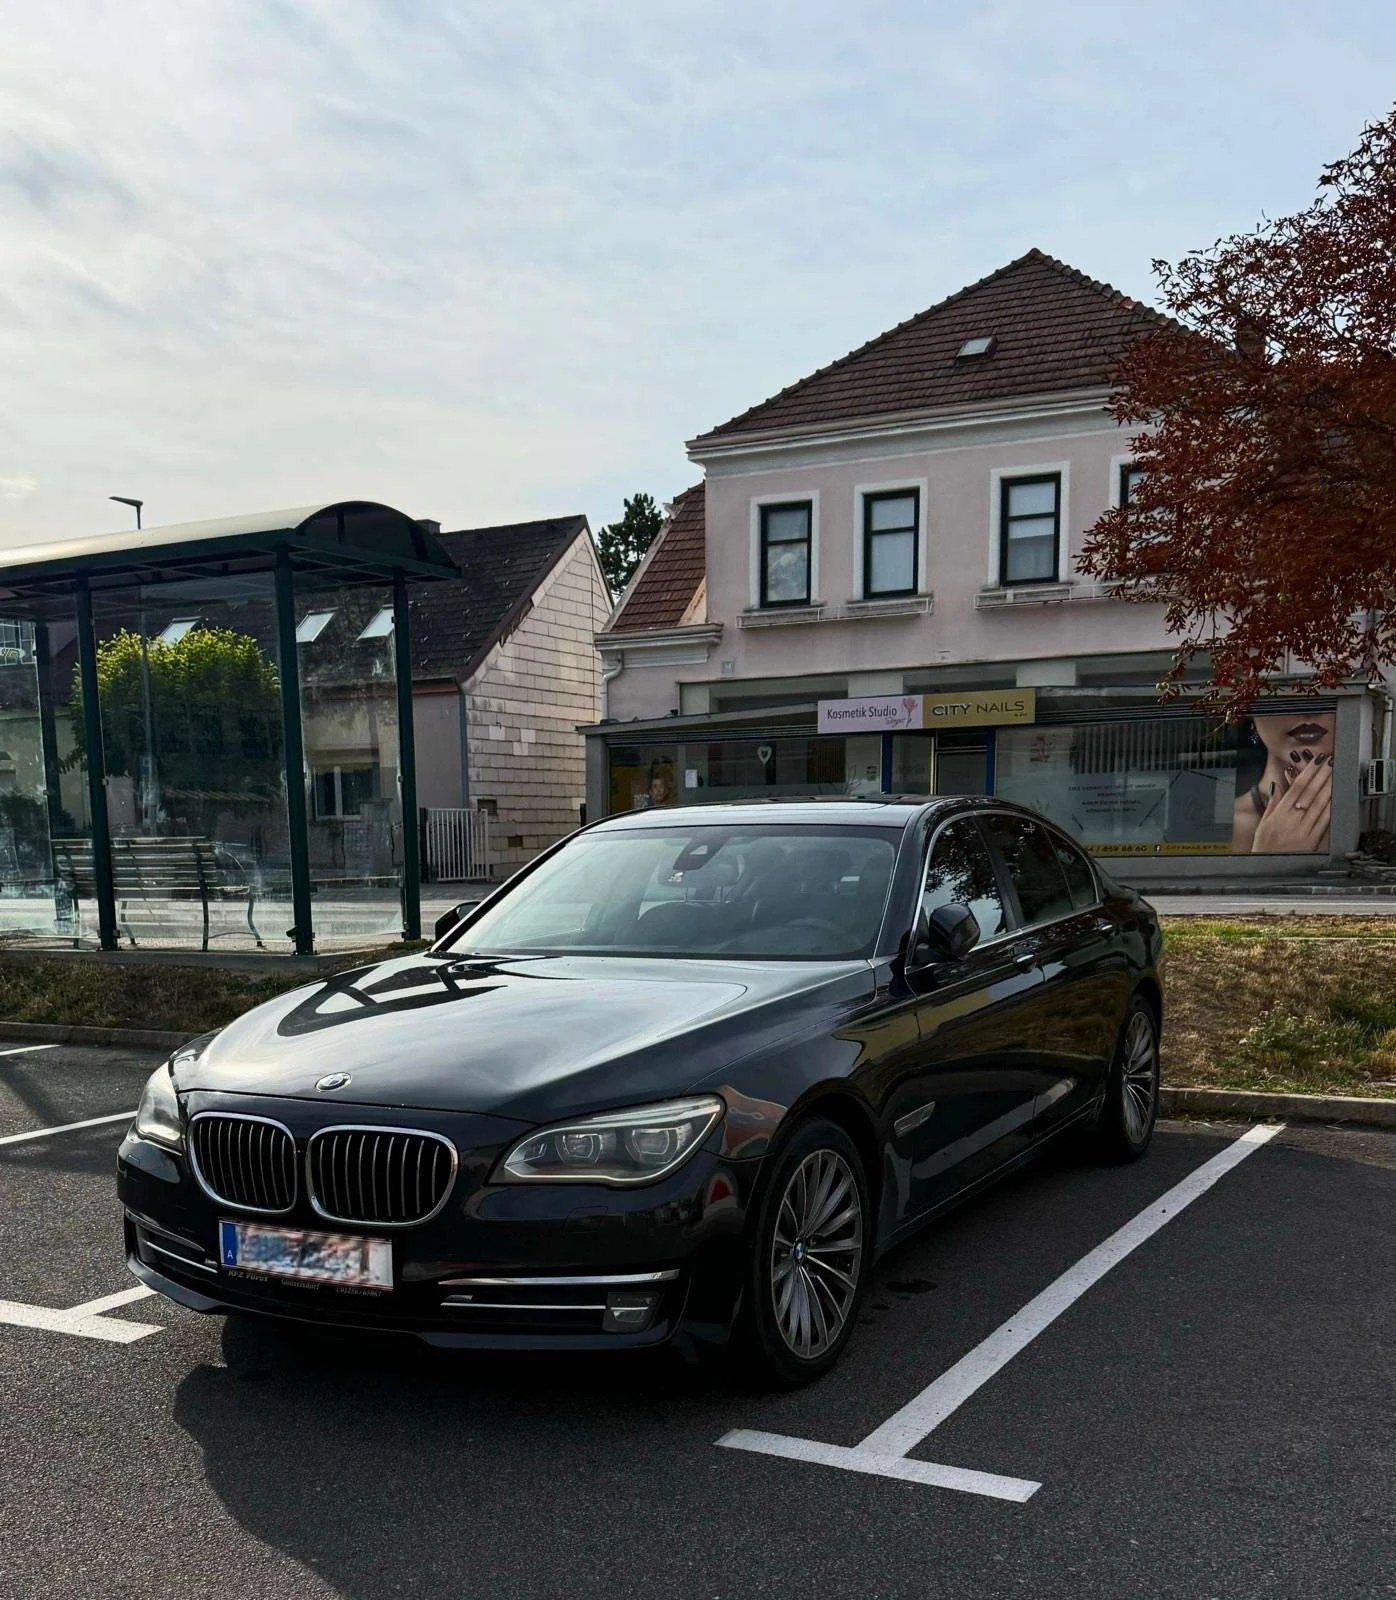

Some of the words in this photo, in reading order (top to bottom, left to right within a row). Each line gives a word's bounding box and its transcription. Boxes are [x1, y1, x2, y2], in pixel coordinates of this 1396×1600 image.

[827, 708, 867, 720] Kosmetik
[868, 705, 898, 718] Studio
[932, 704, 970, 716] CITY
[976, 700, 1025, 714] NAILS
[227, 1249, 233, 1259] A
